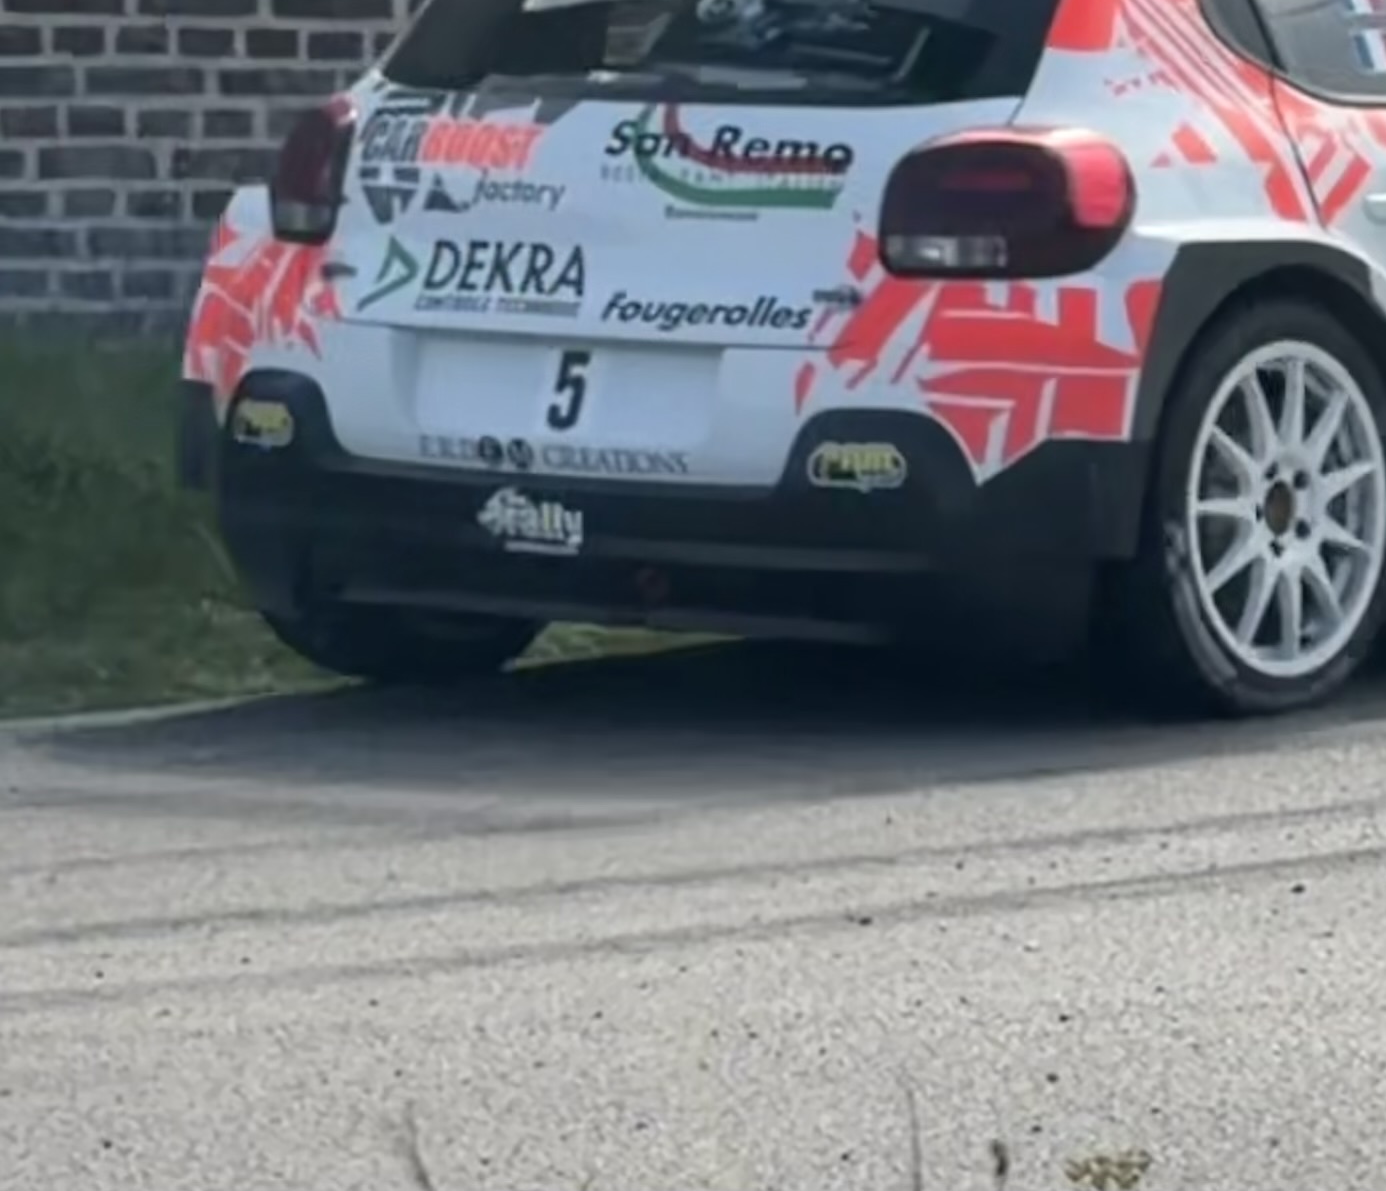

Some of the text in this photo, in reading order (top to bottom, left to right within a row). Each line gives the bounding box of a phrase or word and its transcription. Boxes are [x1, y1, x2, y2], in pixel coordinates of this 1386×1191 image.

[604, 120, 854, 168] San Remo
[467, 169, 566, 211] factory
[423, 239, 584, 298] DEKRA
[601, 290, 812, 332] fougerolles
[546, 350, 592, 431] 5
